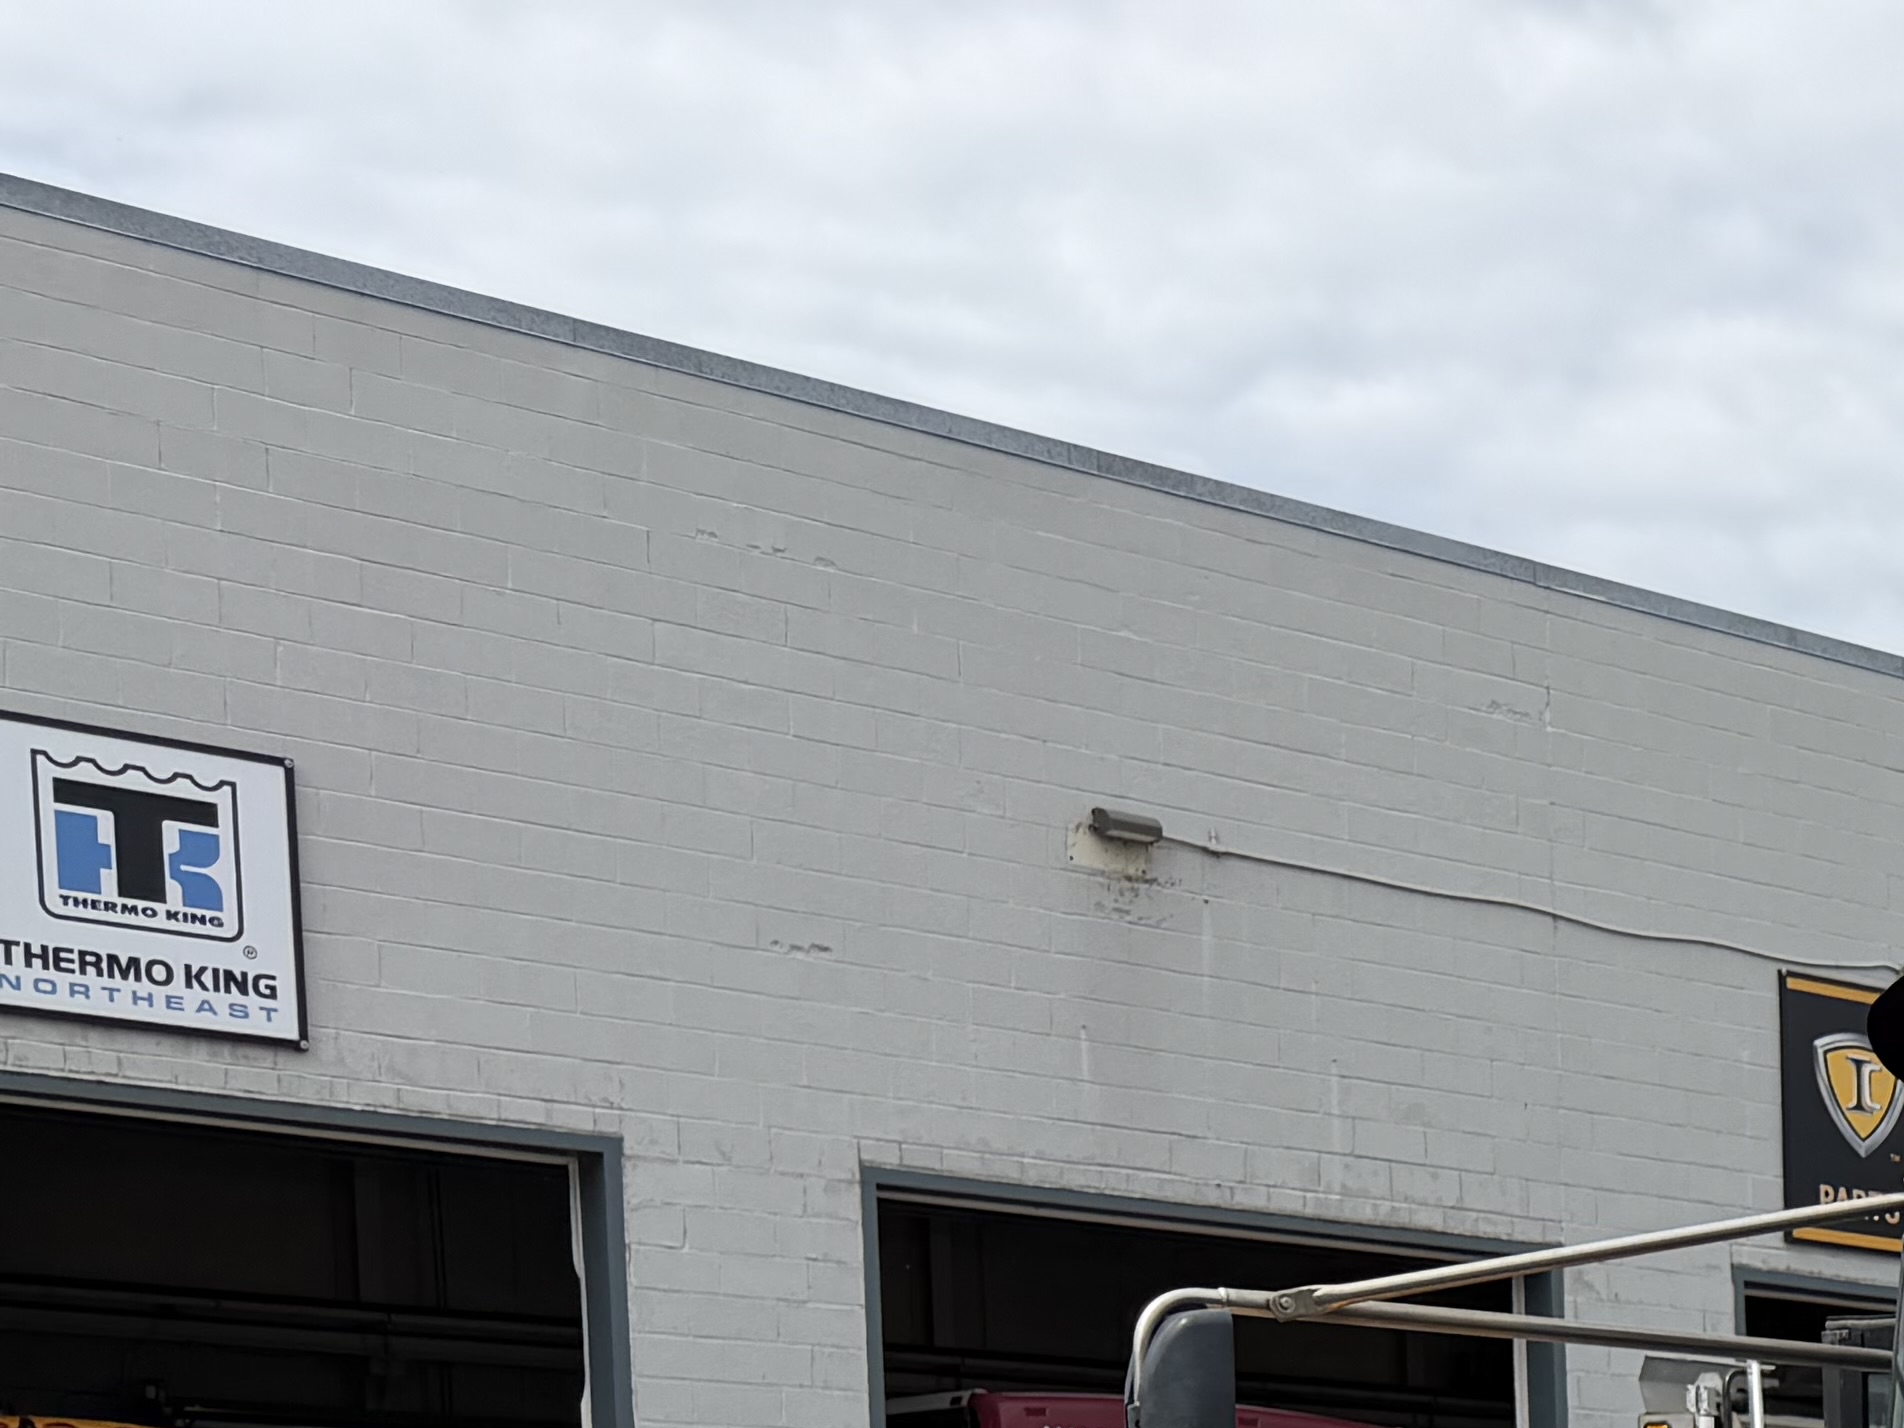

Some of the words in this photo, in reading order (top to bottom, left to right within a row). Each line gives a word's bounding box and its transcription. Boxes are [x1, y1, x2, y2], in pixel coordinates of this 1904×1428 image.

[59, 894, 158, 919] THERMO
[165, 909, 225, 929] KING
[0, 940, 175, 987] THERMO
[184, 963, 279, 1001] KING
[0, 975, 279, 1022] NORTHEAST
